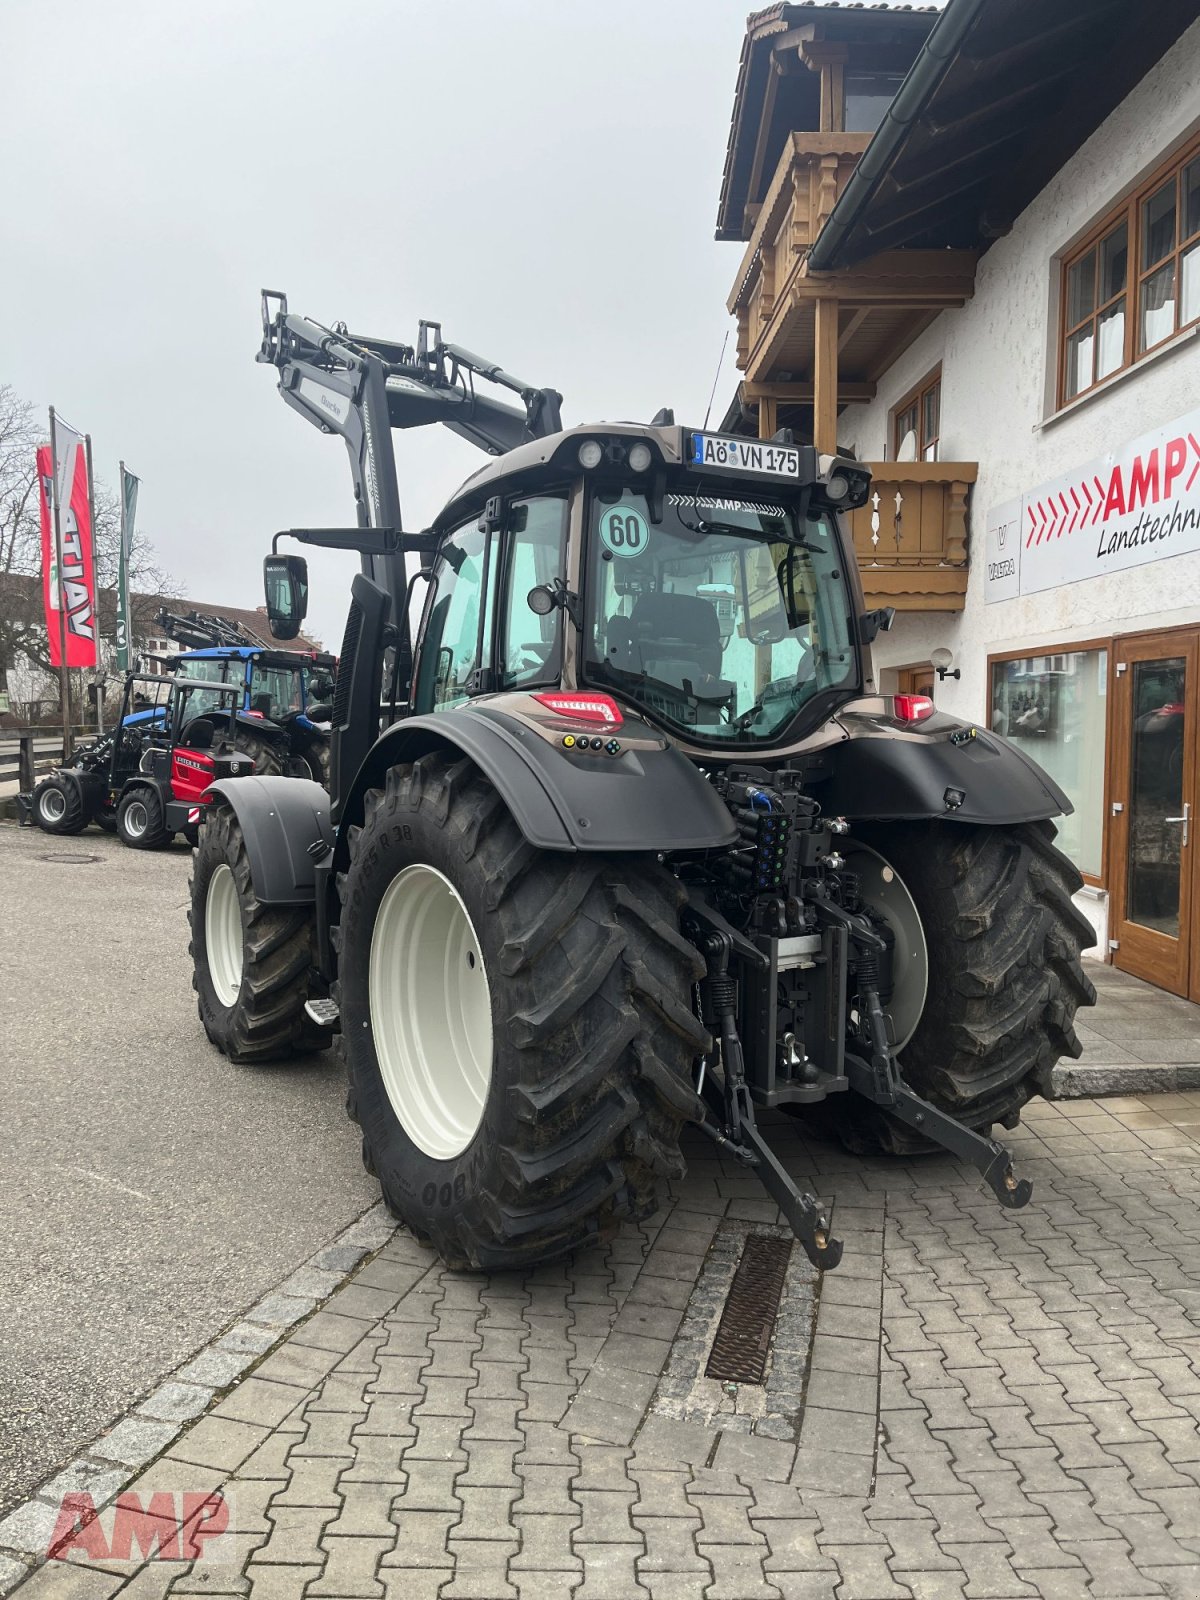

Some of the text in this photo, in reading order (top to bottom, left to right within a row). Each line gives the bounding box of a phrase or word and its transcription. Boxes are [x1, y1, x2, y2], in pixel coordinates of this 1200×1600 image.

[705, 440, 727, 463] AÖ
[740, 444, 762, 468] VN
[766, 449, 797, 473] 175
[1102, 437, 1187, 521] AMP
[609, 514, 640, 547] 60
[988, 558, 1015, 581] VALTRA
[392, 824, 412, 841] 38
